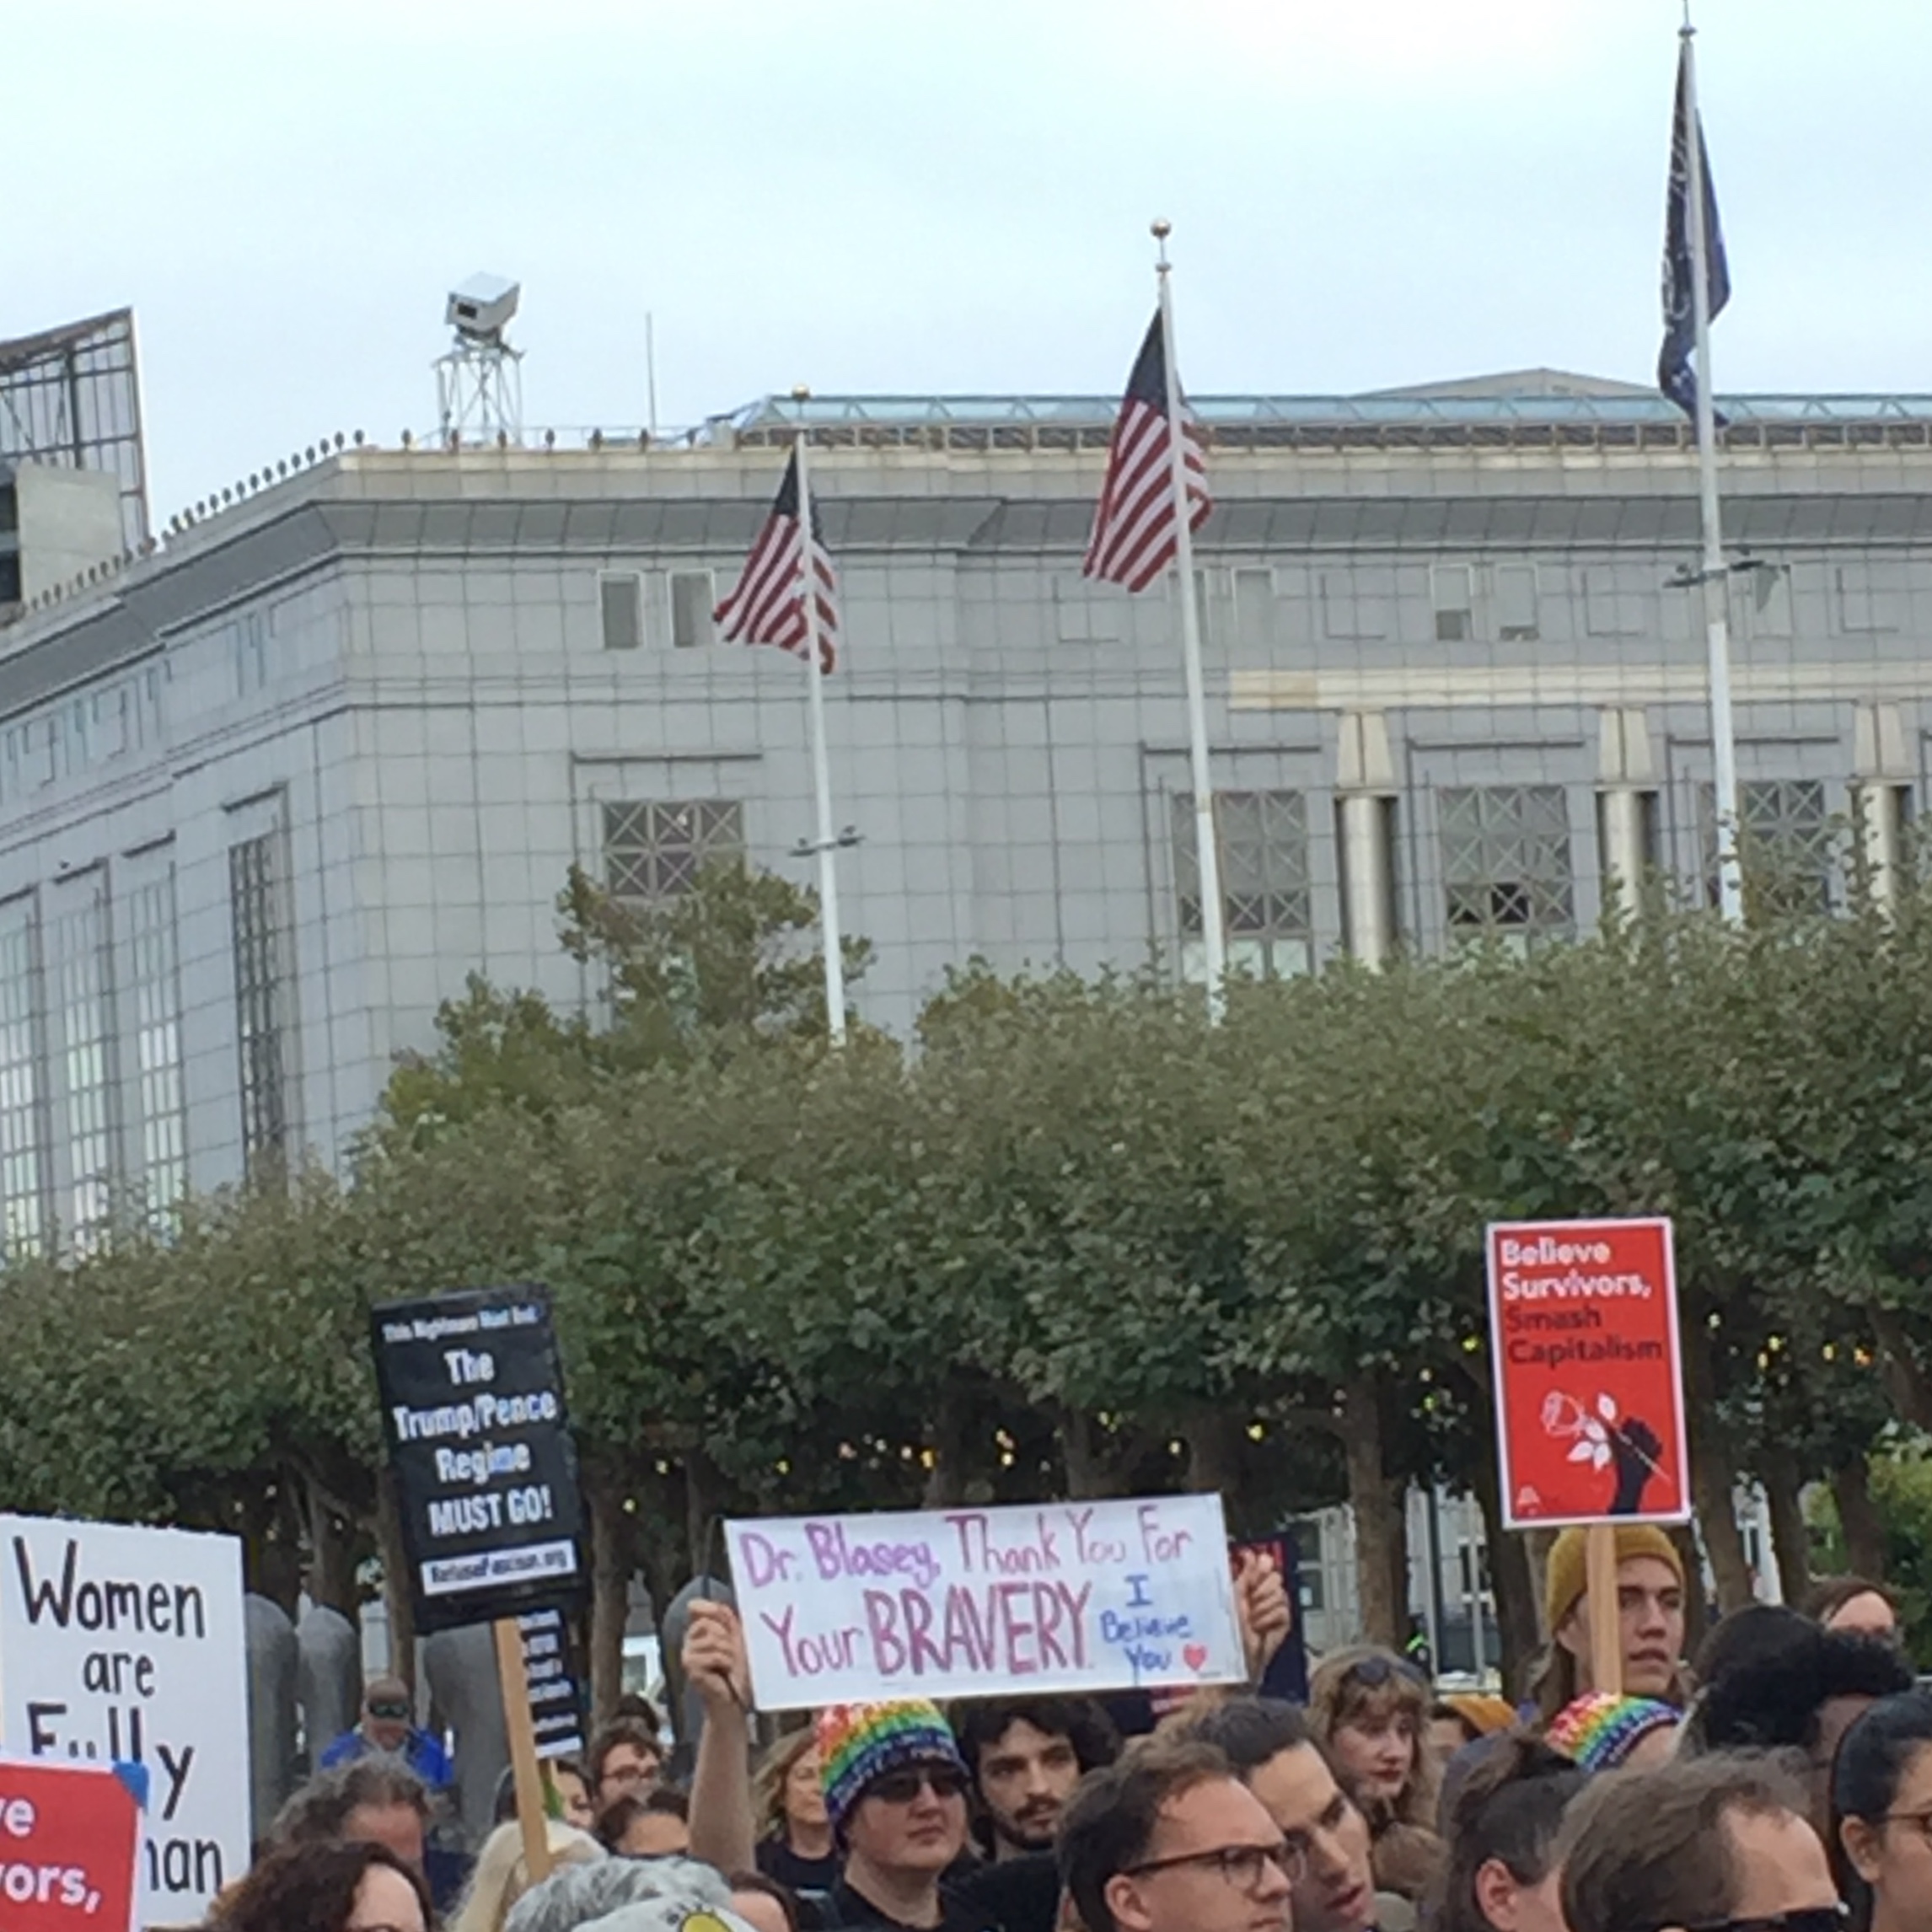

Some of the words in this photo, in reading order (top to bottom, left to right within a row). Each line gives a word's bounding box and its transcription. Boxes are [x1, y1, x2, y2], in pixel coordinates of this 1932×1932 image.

[1500, 1236, 1610, 1265] Believe
[1502, 1269, 1651, 1300] Survivors,
[1505, 1304, 1601, 1333] Smash
[443, 1349, 495, 1385] The
[1508, 1334, 1663, 1371] Capitalism
[393, 1393, 558, 1441] Trump/Pence
[435, 1441, 531, 1484] Regime
[428, 1494, 502, 1537] MUST
[507, 1484, 553, 1524] GO!
[738, 1532, 803, 1588] Dr.
[804, 1521, 942, 1588] Blasey,
[945, 1511, 1060, 1574] Thank
[1065, 1507, 1127, 1564] You
[1137, 1505, 1193, 1564] For
[12, 1535, 206, 1639] Women
[1124, 1574, 1153, 1607] I
[759, 1604, 864, 1677] Your
[1099, 1610, 1193, 1643] Believe
[83, 1652, 155, 1698] are
[1124, 1645, 1173, 1687] You
